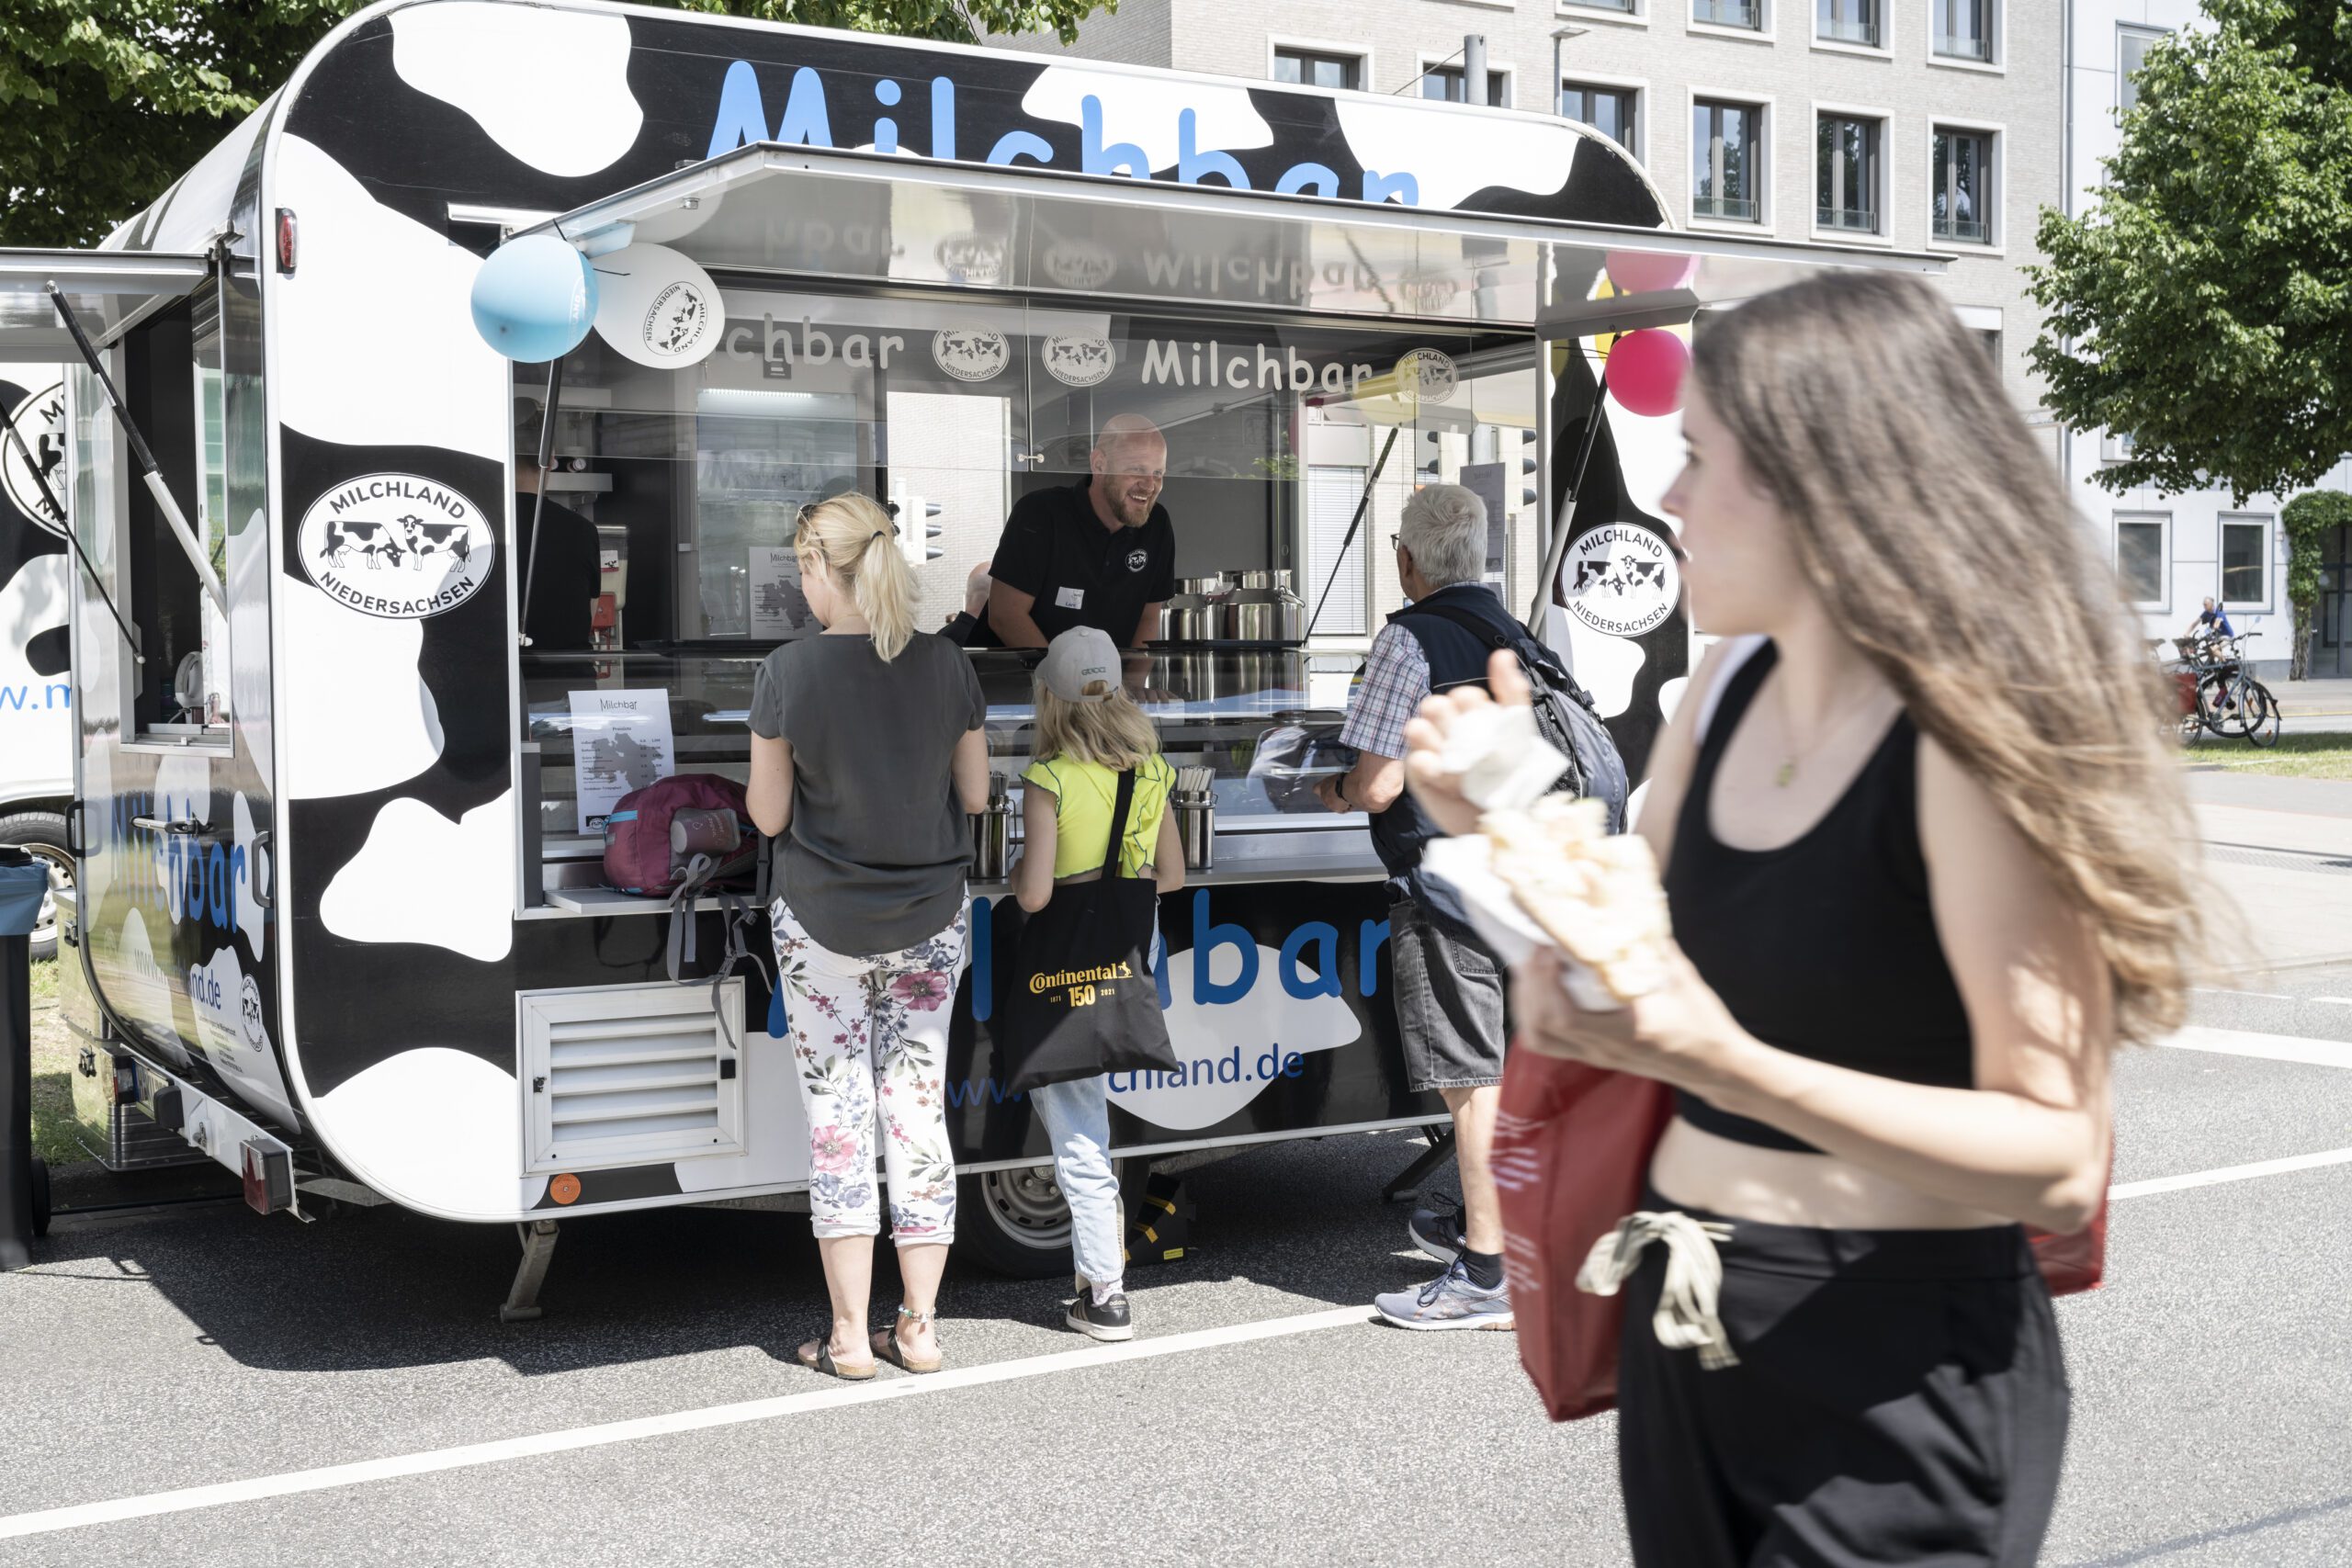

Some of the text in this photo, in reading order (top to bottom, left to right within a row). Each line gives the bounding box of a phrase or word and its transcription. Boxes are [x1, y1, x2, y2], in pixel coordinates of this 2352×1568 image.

[645, 285, 681, 342] NIEDERSACHSEN
[673, 302, 706, 353] MILCHLAND
[726, 312, 905, 369] chbar
[944, 361, 1001, 379] NIEDERSACHSEN
[1053, 367, 1106, 384] NIEDERSACHSEN
[1141, 338, 1373, 394] Milchbar
[329, 481, 465, 519] MILCHLAND
[1579, 529, 1663, 558] MILCHLAND
[320, 571, 475, 615] NIEDERSACHSEN
[1573, 600, 1668, 633] NIEDERSACHSEN
[599, 698, 638, 712] Milchbar
[1029, 963, 1118, 994] Continental
[1068, 985, 1096, 1008] 150
[1101, 988, 1115, 997] 2021
